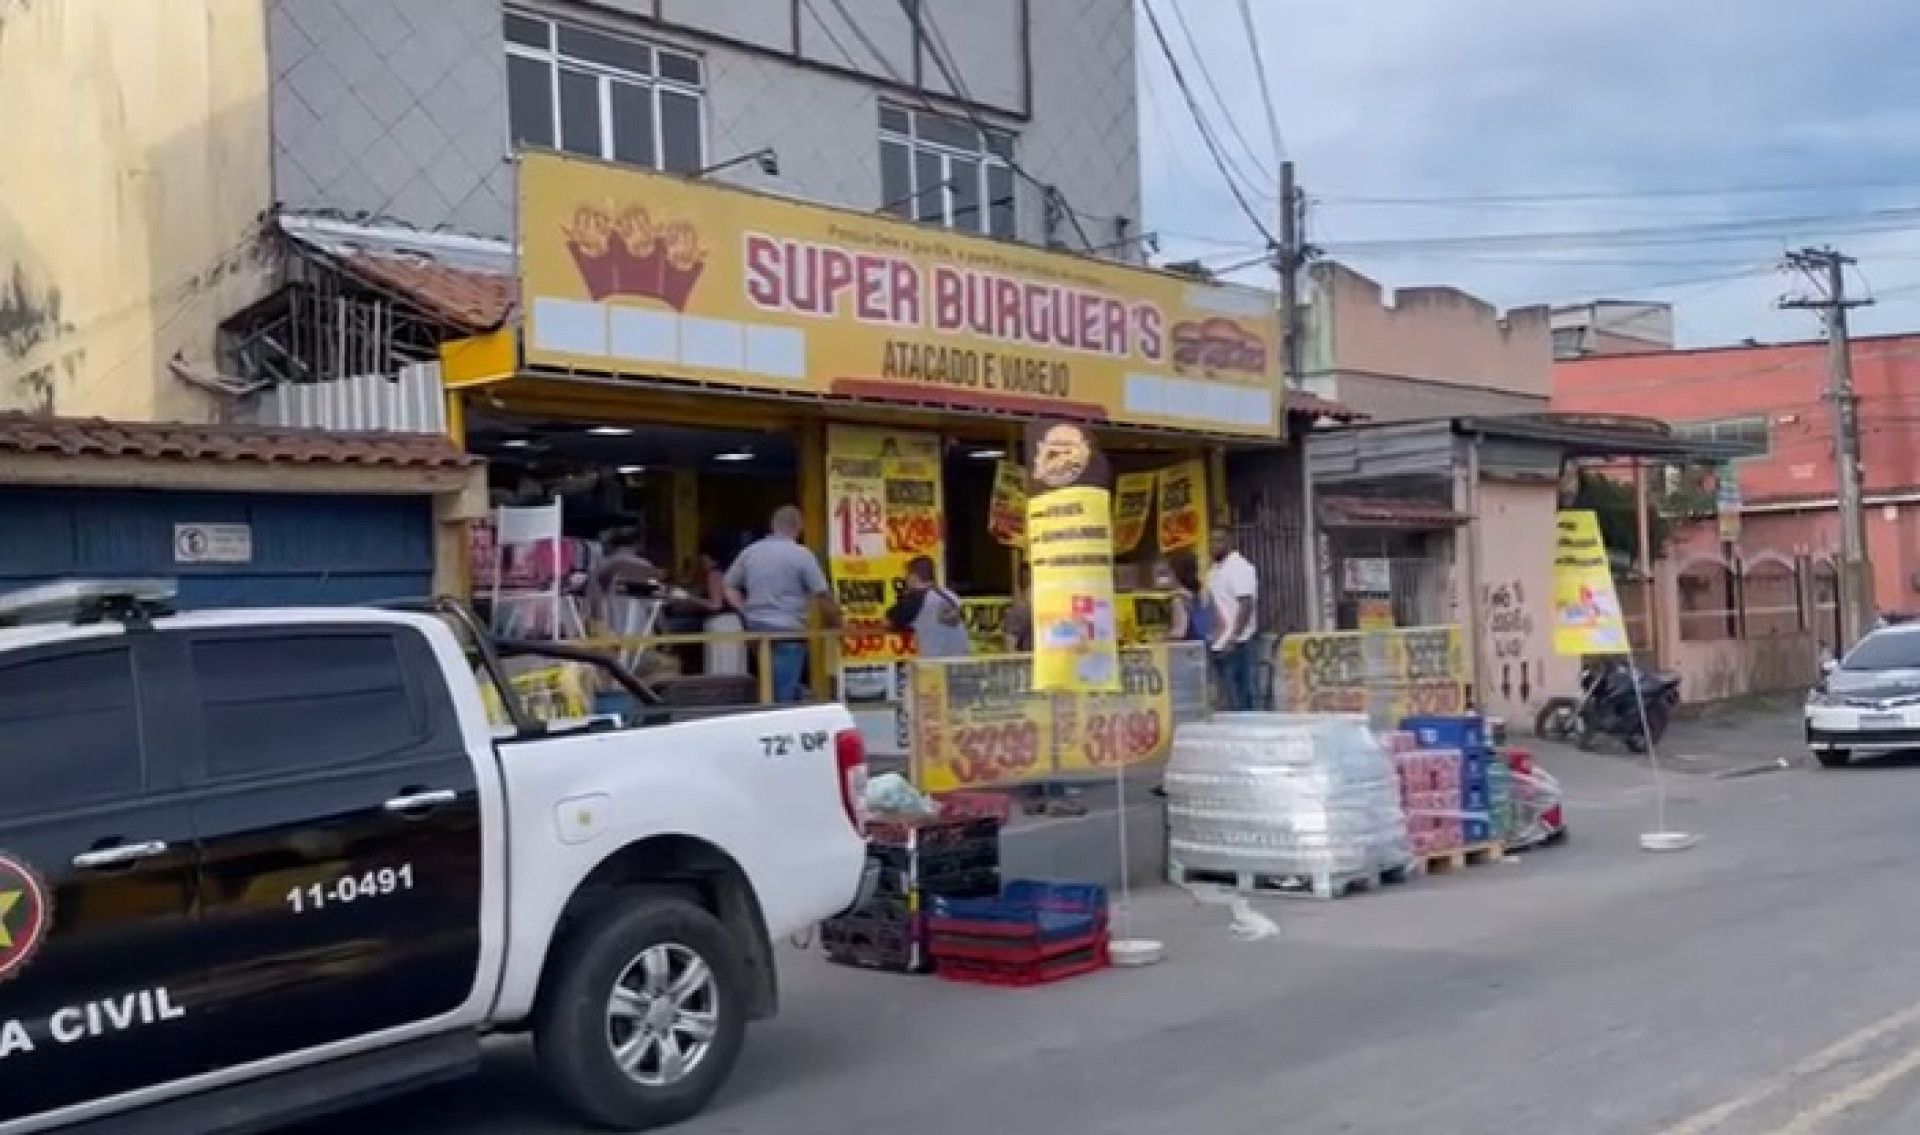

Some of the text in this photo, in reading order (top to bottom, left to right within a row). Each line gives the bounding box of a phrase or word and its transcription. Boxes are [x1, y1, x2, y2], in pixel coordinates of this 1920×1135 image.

[743, 231, 1163, 361] SUPER BURGUER'S
[883, 341, 1070, 397] ATACADO E VAREJO
[800, 730, 828, 753] DP
[286, 862, 414, 914] 11-0491
[49, 986, 186, 1044] CIVIL
